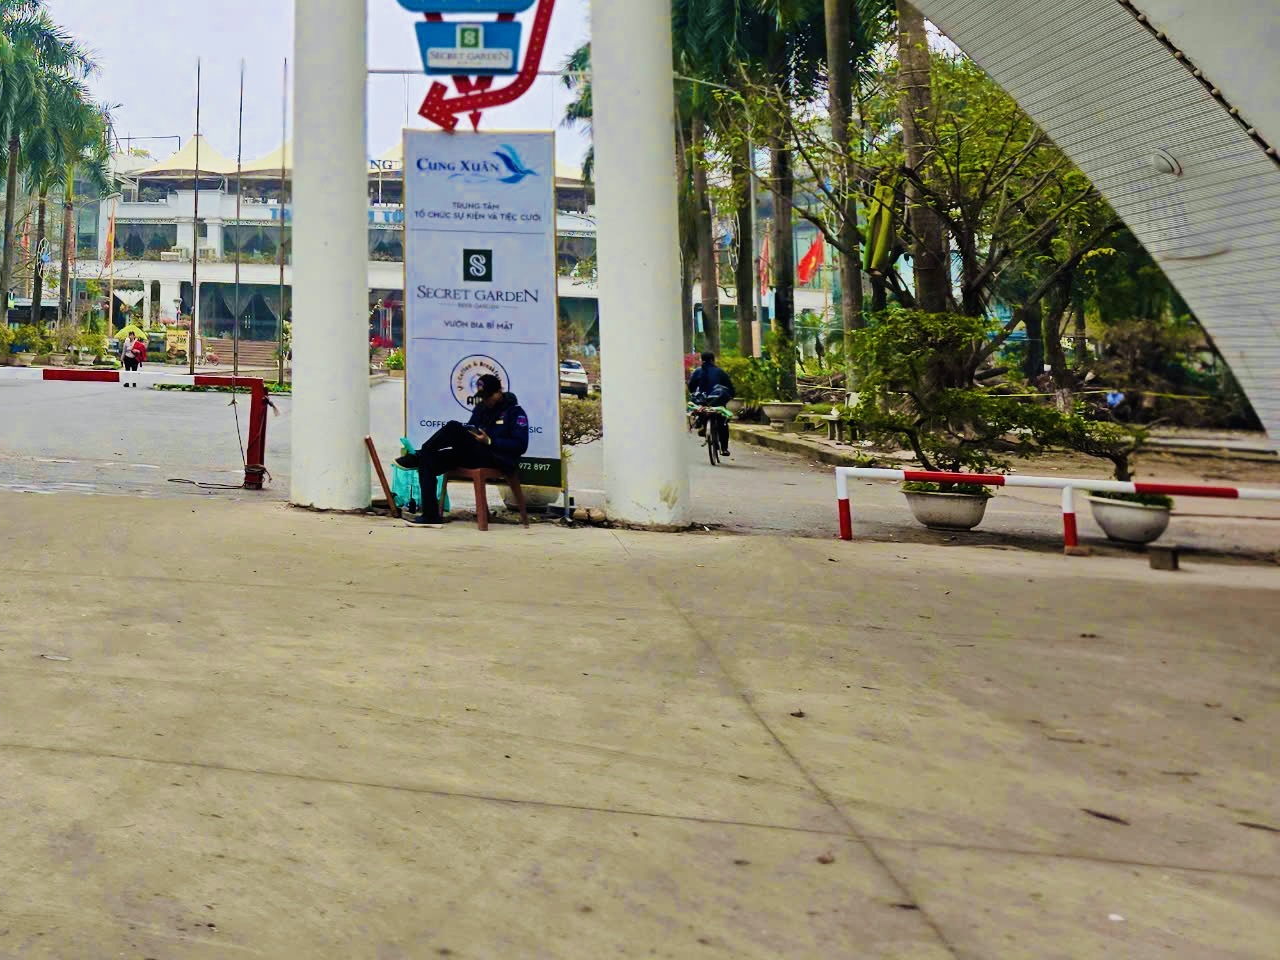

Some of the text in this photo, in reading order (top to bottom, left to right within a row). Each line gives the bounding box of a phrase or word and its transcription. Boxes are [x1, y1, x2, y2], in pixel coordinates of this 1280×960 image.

[452, 201, 480, 210] TRUNG
[417, 284, 539, 304] SECRET GARDEN
[419, 419, 447, 428] COFFE
